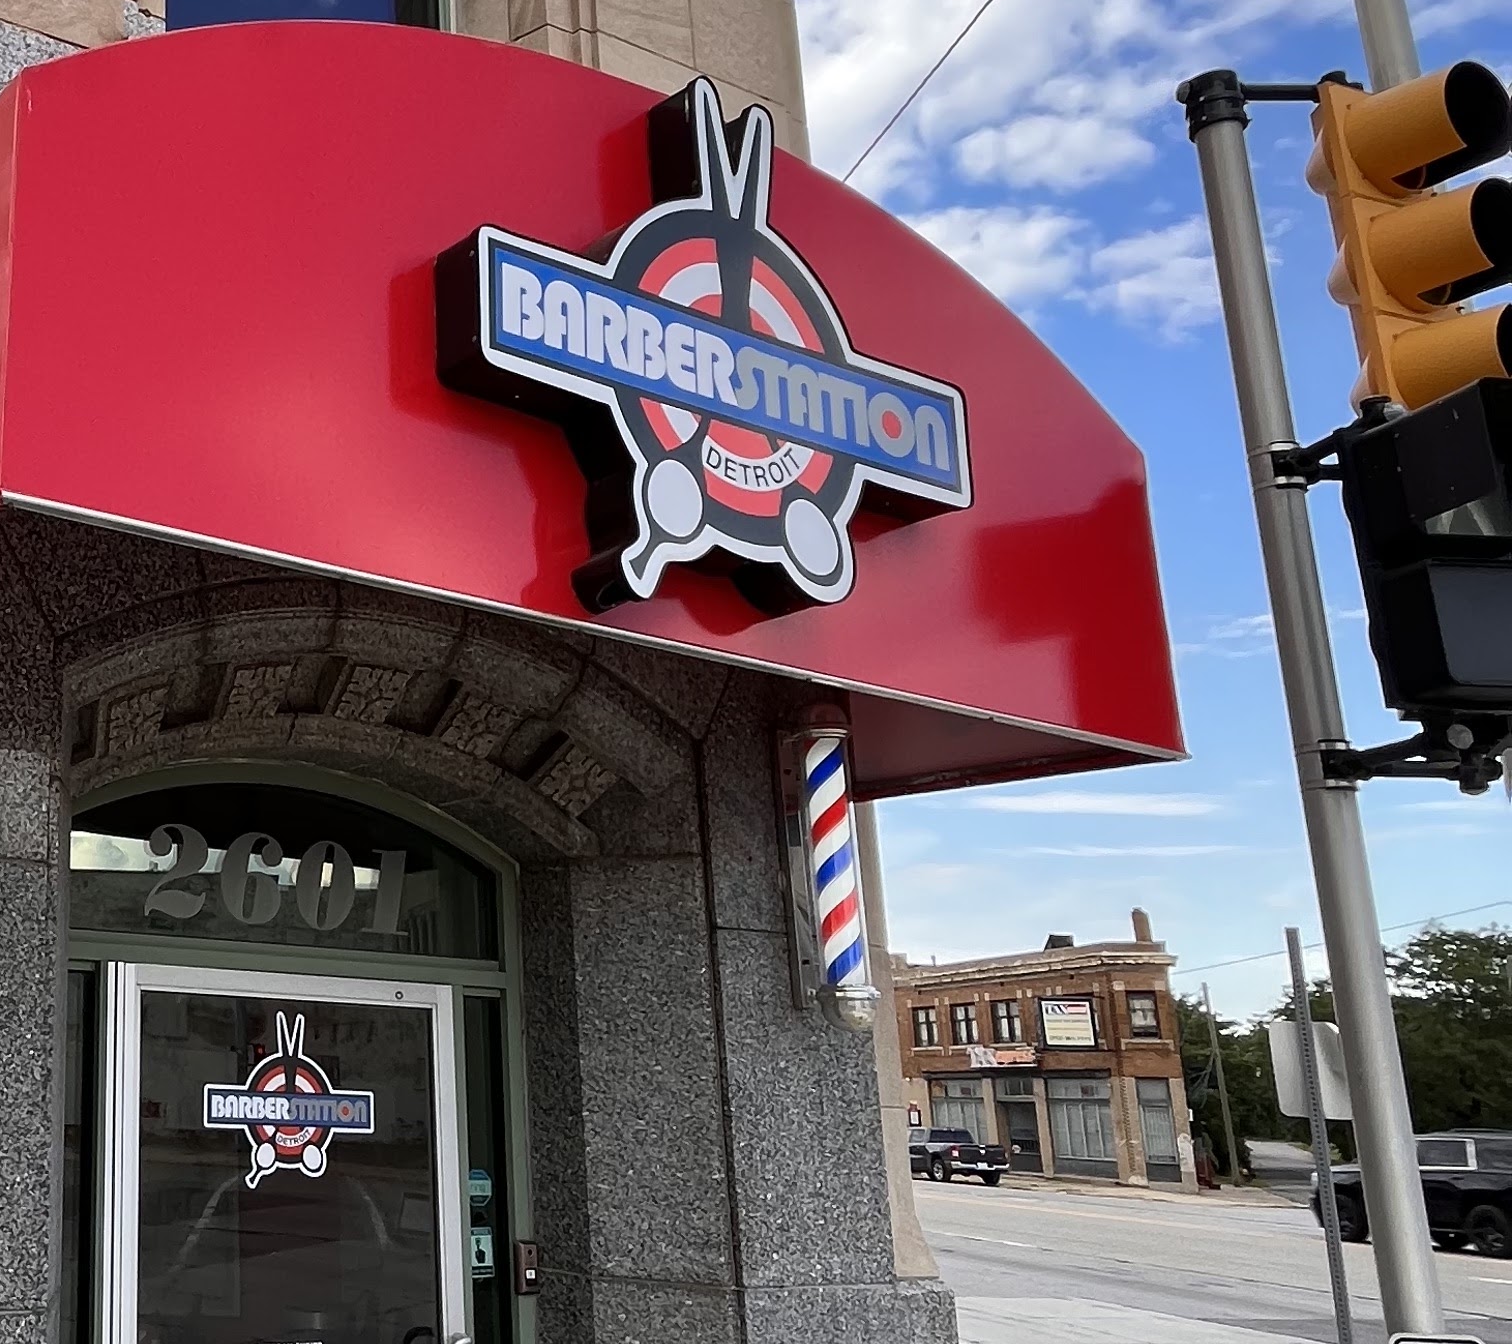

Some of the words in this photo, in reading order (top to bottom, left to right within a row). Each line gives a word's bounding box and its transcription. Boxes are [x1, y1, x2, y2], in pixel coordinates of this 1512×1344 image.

[705, 445, 800, 487] DETROIT
[144, 823, 409, 936] 2601
[276, 1129, 311, 1146] DETROIT
